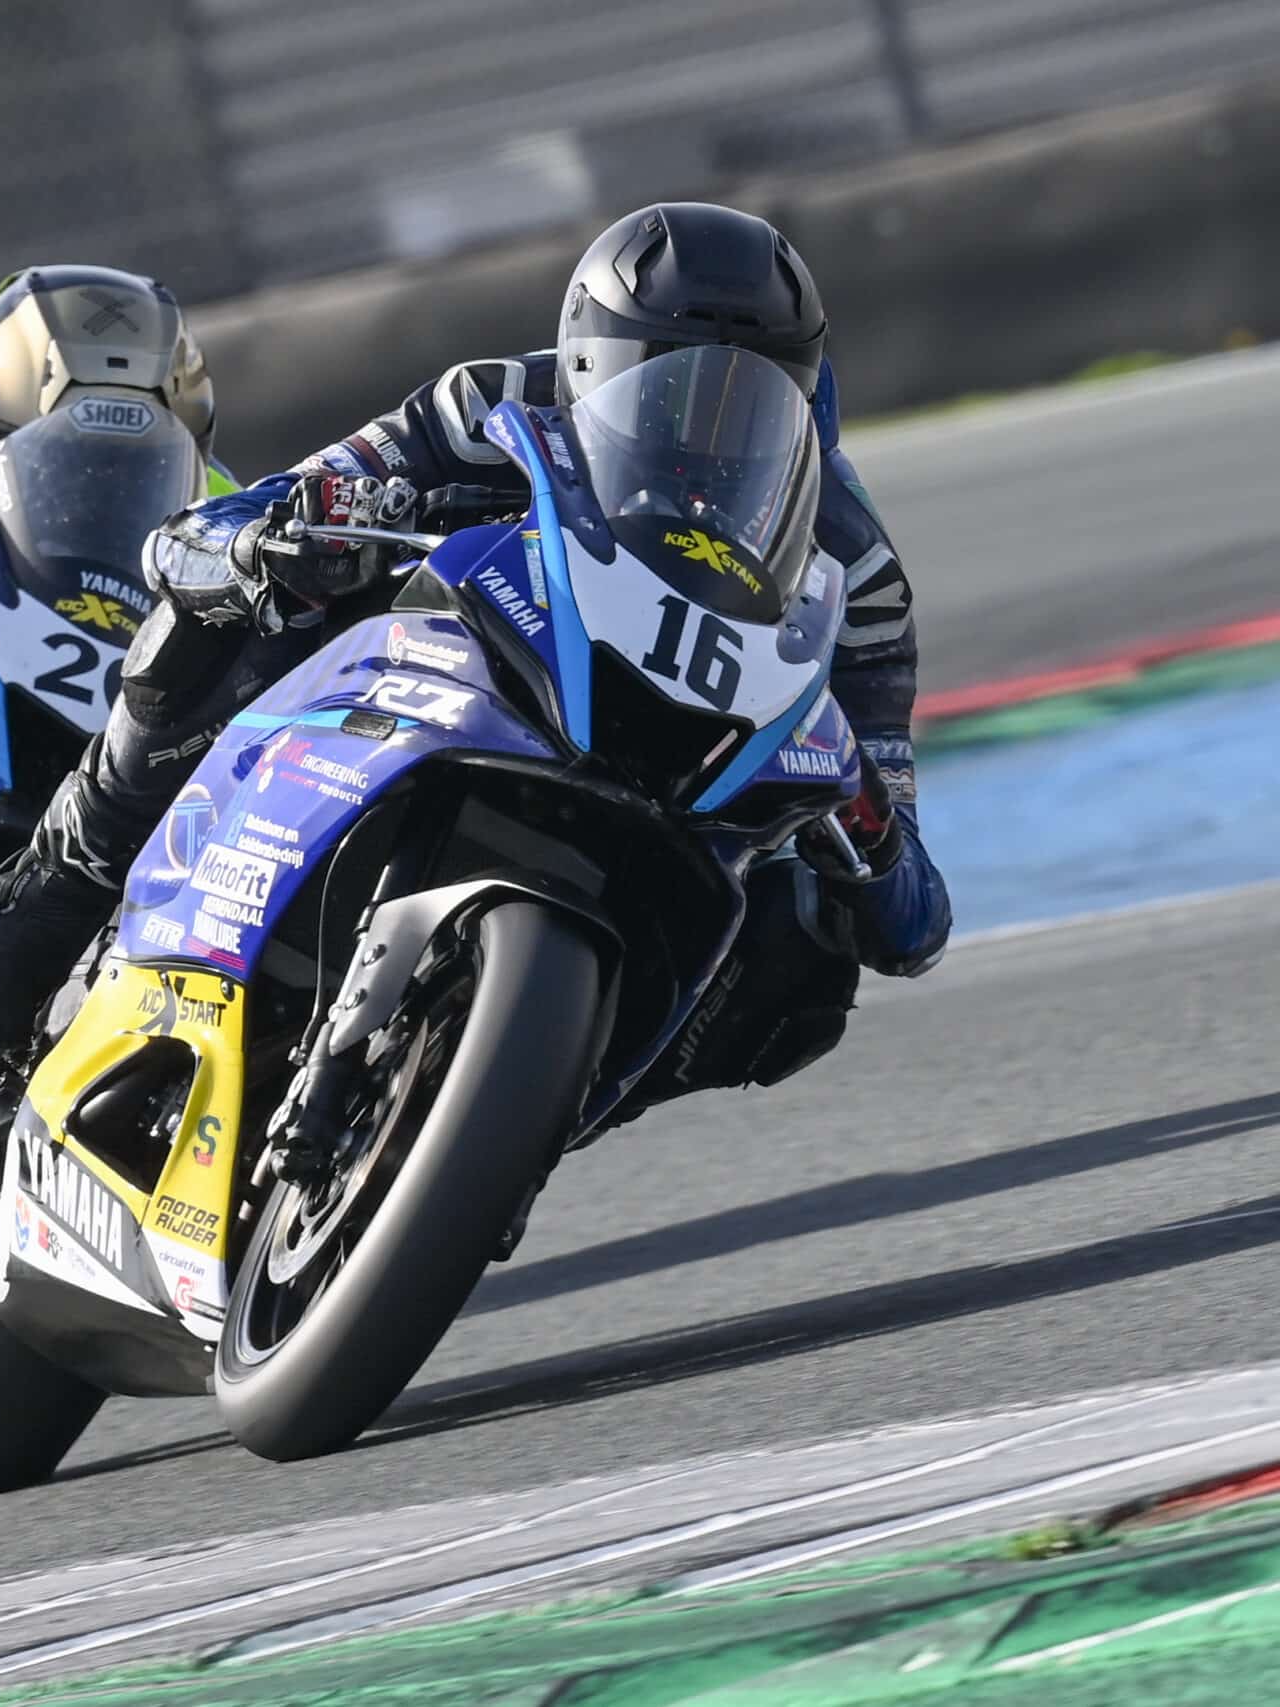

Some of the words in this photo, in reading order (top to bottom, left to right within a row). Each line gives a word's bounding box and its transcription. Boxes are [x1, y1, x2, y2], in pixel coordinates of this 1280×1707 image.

[79, 402, 145, 428] SHOEI
[80, 571, 152, 614] YAMAHA
[477, 565, 546, 637] YAMAHA
[640, 593, 745, 713] 16
[33, 633, 126, 722] 2
[354, 674, 476, 727] R7
[300, 753, 369, 790] ENGINEERING
[778, 748, 842, 777] YAMAHA
[317, 782, 363, 806] PRODUCTS
[200, 848, 269, 901] MotoFit
[24, 1127, 123, 1272] YAMAHA
[156, 1195, 220, 1229] MOTOR
[155, 1212, 218, 1247] RIJDER
